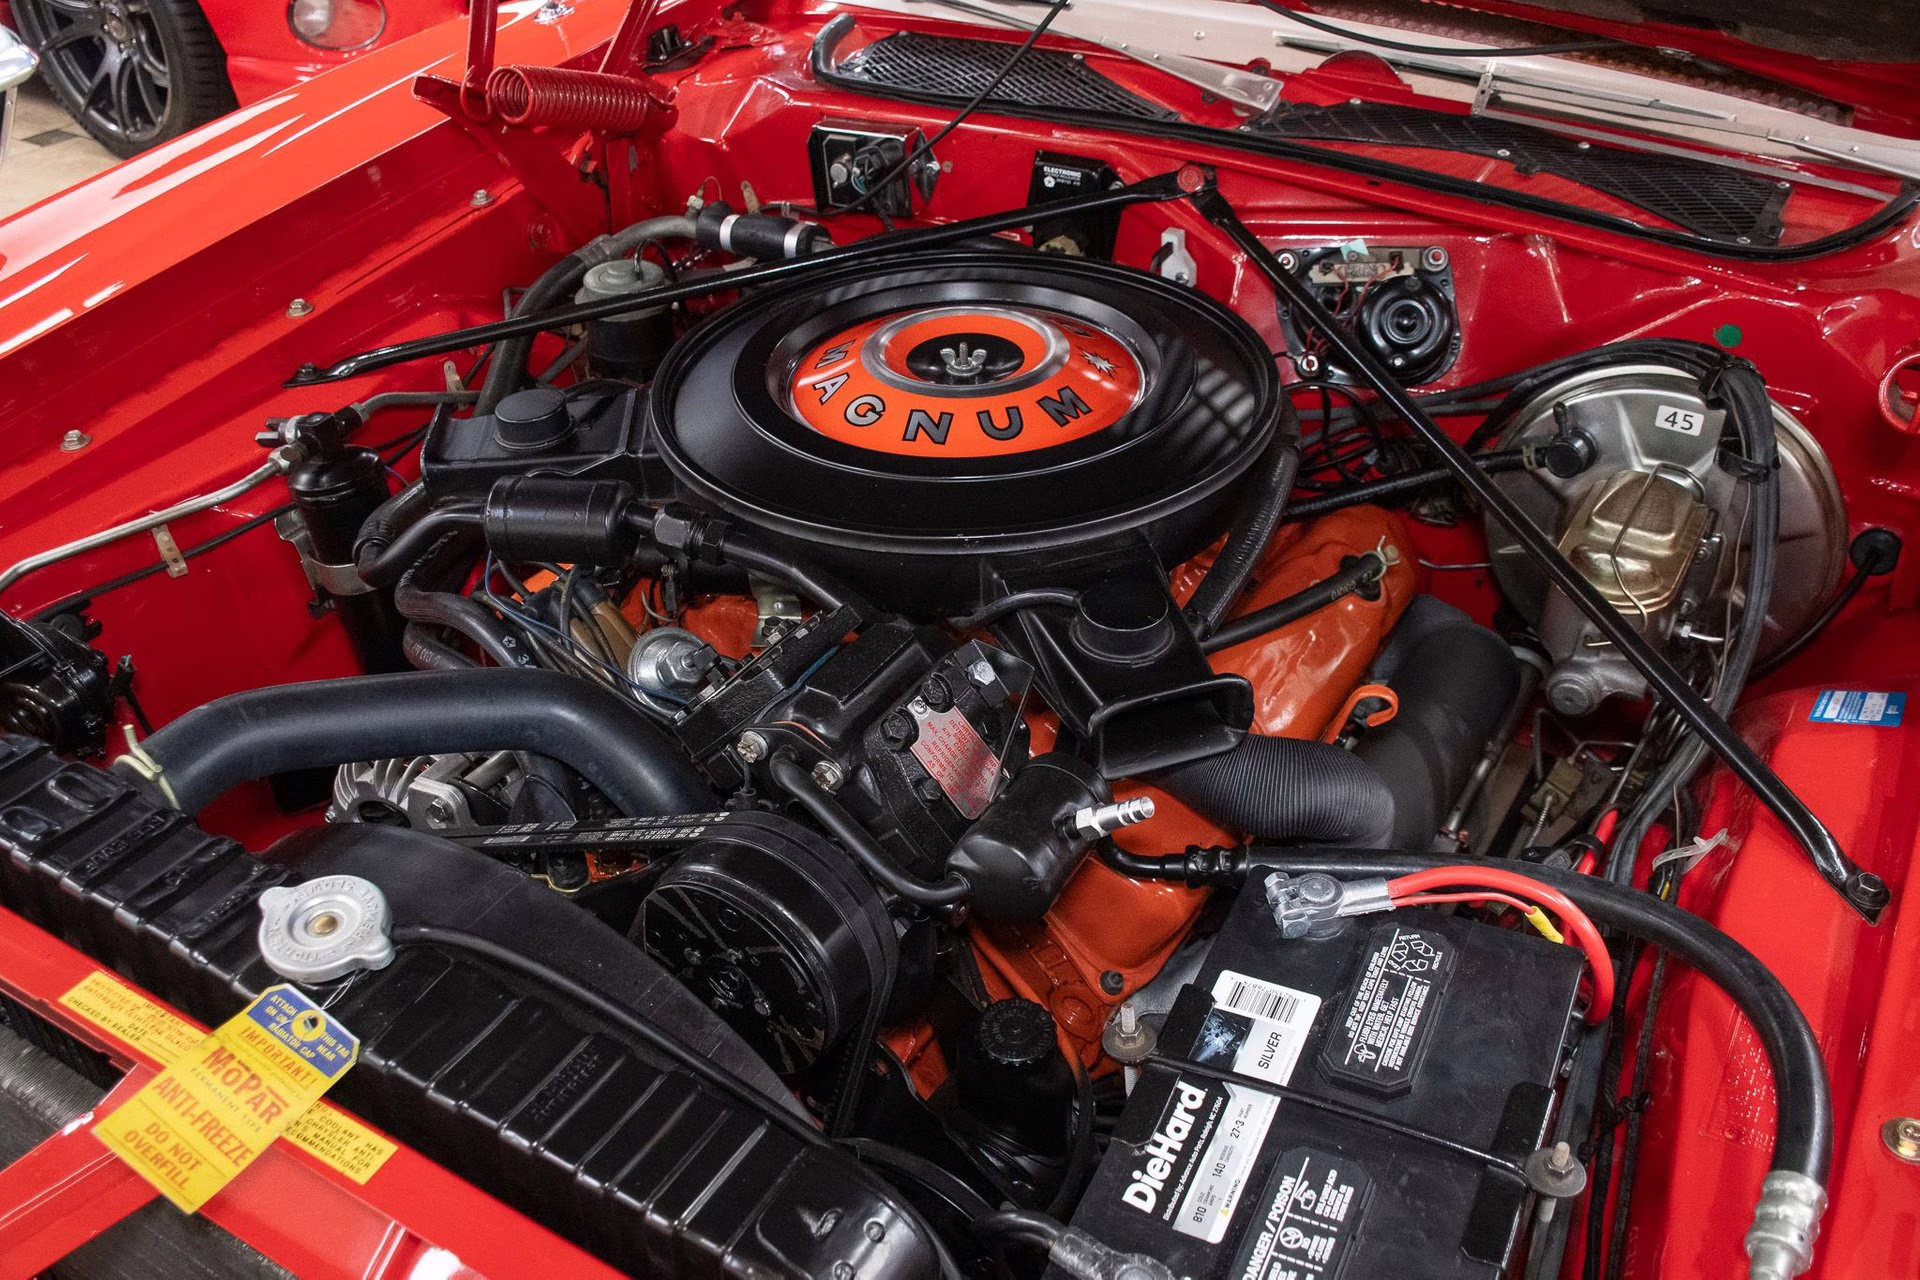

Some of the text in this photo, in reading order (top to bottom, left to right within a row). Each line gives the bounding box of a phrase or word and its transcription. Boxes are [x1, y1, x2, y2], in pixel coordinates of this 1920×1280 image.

[1043, 166, 1081, 177] ELECTRONIC
[812, 338, 1092, 445] MAGNUM
[1664, 412, 1694, 430] 45
[927, 721, 938, 734] MAX
[938, 735, 957, 759] CHARGE
[941, 727, 951, 737] AIR
[67, 996, 101, 1017] CHECKED
[111, 1022, 141, 1041] DEALER
[127, 1023, 148, 1036] DATE
[270, 994, 350, 1058] ATTACH THIS TAG
[1359, 978, 1388, 1042] FLUSH EYES IMMEDIATELY
[1367, 1030, 1377, 1045] WITH
[1380, 1000, 1388, 1011] GET
[1375, 997, 1398, 1047] MEDICAL HELP FAST
[265, 1005, 336, 1061] ON OR NEAR
[268, 1022, 315, 1059] RADIATOR CAP
[1257, 1030, 1282, 1069] SILVER
[239, 1025, 318, 1088] IMPORTANT!
[152, 1074, 255, 1167] ANTI-FREEZE
[305, 1118, 350, 1146] CHRYSLER
[318, 1115, 359, 1141] COOLANT
[364, 1141, 383, 1156] HAS
[1230, 1119, 1244, 1138] 27-3
[121, 1128, 194, 1191] OVERFILL
[142, 1121, 203, 1174] DO NOT
[284, 1126, 361, 1174] ECOMMENDATIONS
[312, 1132, 371, 1169] MANUAL FOR
[1121, 1079, 1208, 1213] DieHard
[1163, 1192, 1180, 1220] Distributed
[1180, 1163, 1192, 1183] Advance
[1189, 1151, 1198, 1163] Auto
[1212, 1162, 1225, 1177] 140
[1325, 1168, 1337, 1184] ACID
[1191, 1205, 1207, 1223] 810
[1269, 1175, 1296, 1222] POISON
